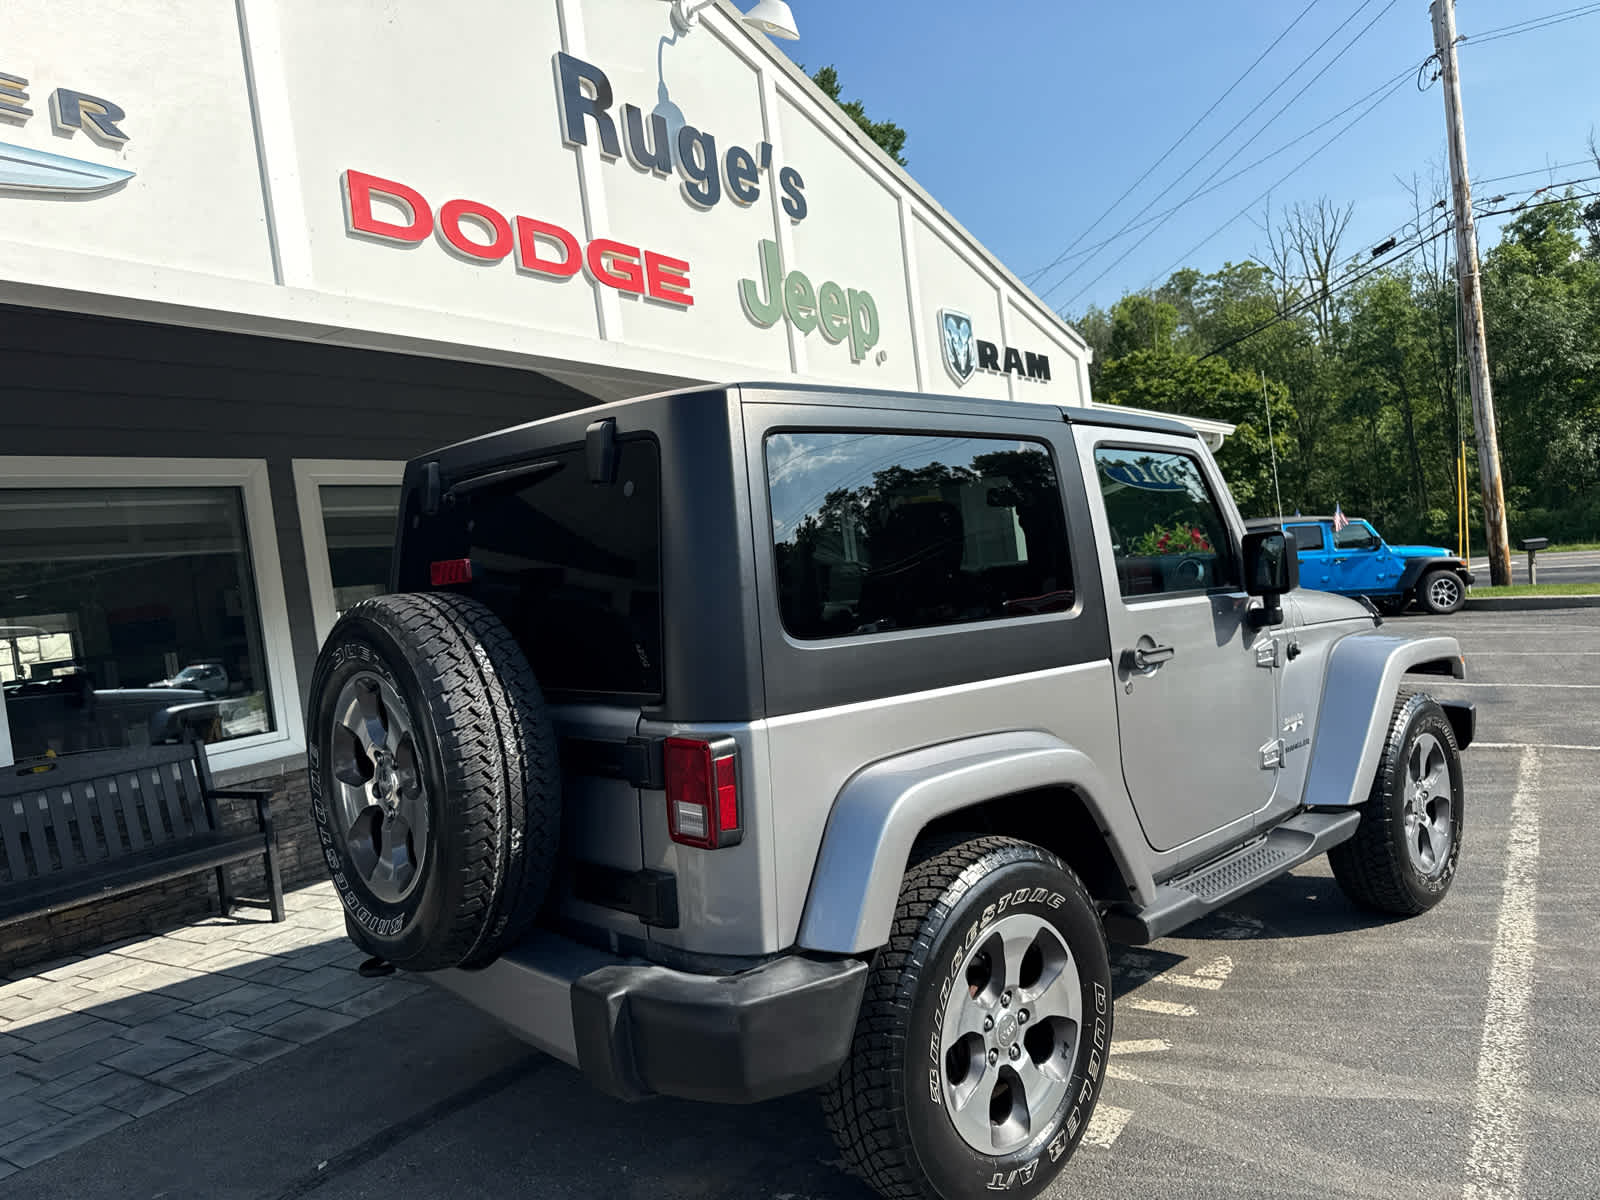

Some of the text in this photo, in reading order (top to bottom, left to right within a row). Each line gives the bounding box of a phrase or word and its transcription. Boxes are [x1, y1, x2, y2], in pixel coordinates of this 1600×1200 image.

[554, 51, 808, 219] Ruge's
[346, 169, 694, 306] DODGE
[738, 239, 880, 361] Jeep
[976, 339, 1051, 381] RAM
[929, 887, 1067, 1105] BRIDGESTONE
[985, 981, 1106, 1191] DUELER A/T
